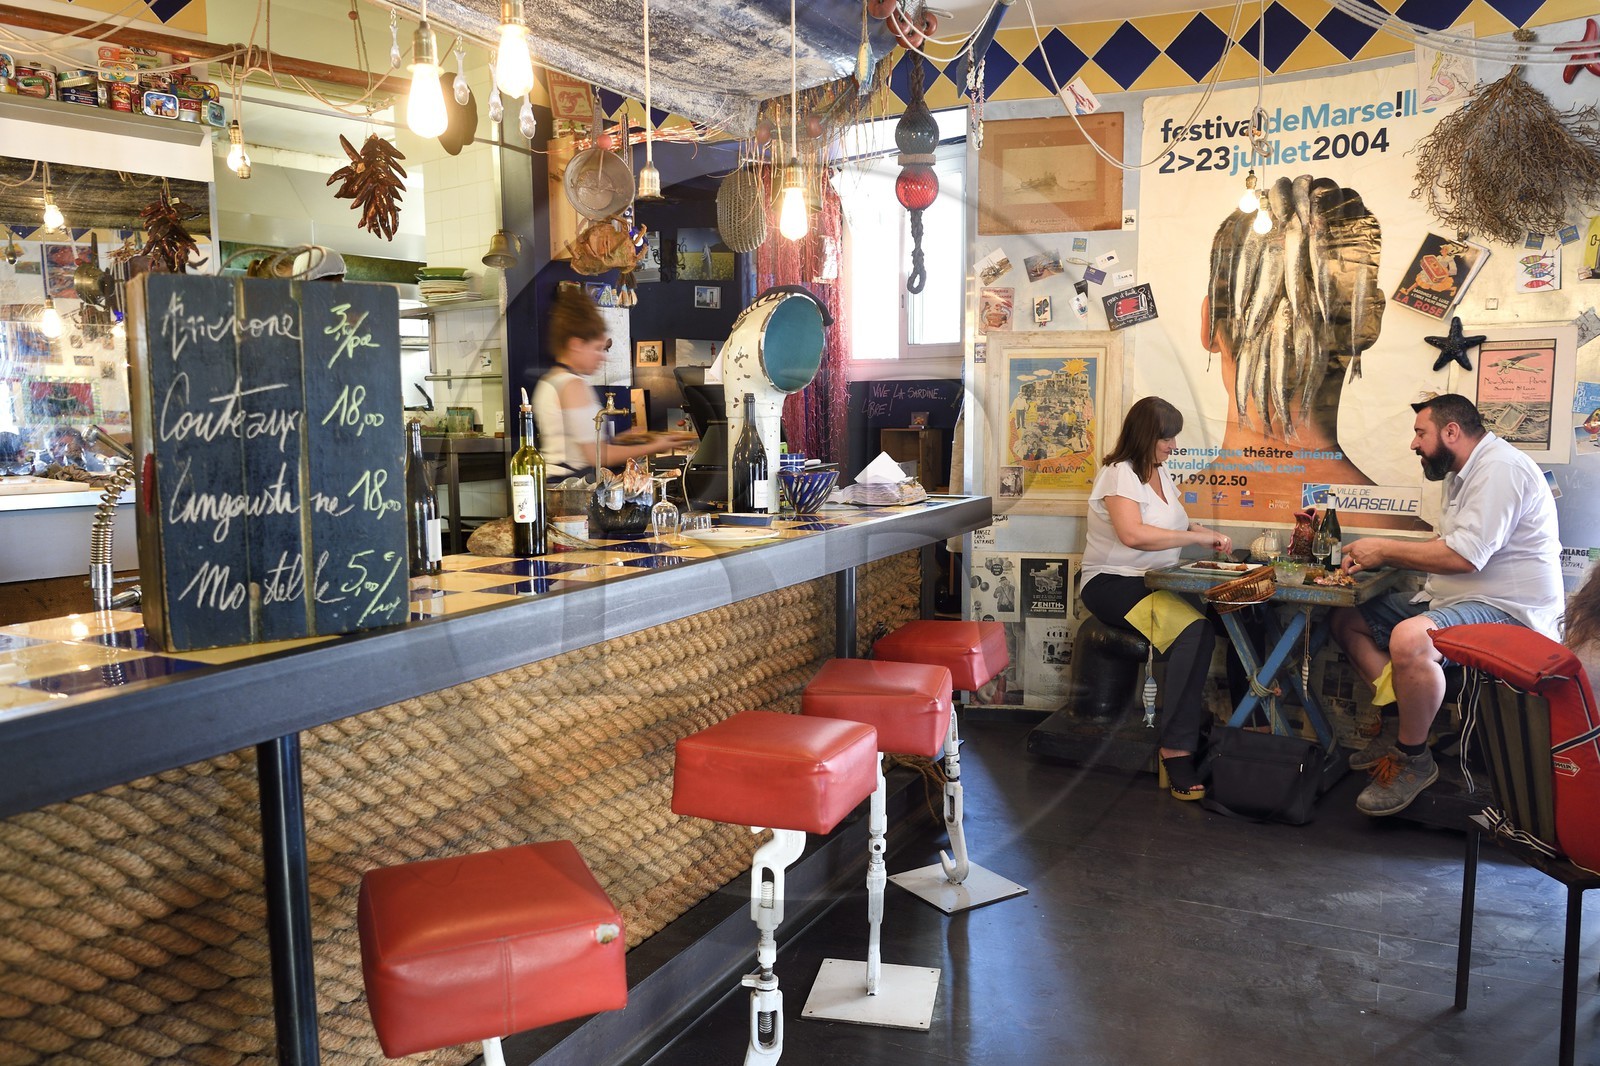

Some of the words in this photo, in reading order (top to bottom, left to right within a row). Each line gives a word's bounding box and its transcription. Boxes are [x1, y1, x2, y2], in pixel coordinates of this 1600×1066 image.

[1394, 292, 1409, 305] LA
[1413, 300, 1443, 317] ROSE
[1337, 488, 1358, 496] VILLE
[1360, 488, 1371, 496] DE
[1336, 497, 1419, 513] MARSEILLE
[1031, 601, 1064, 609] ZENITH
